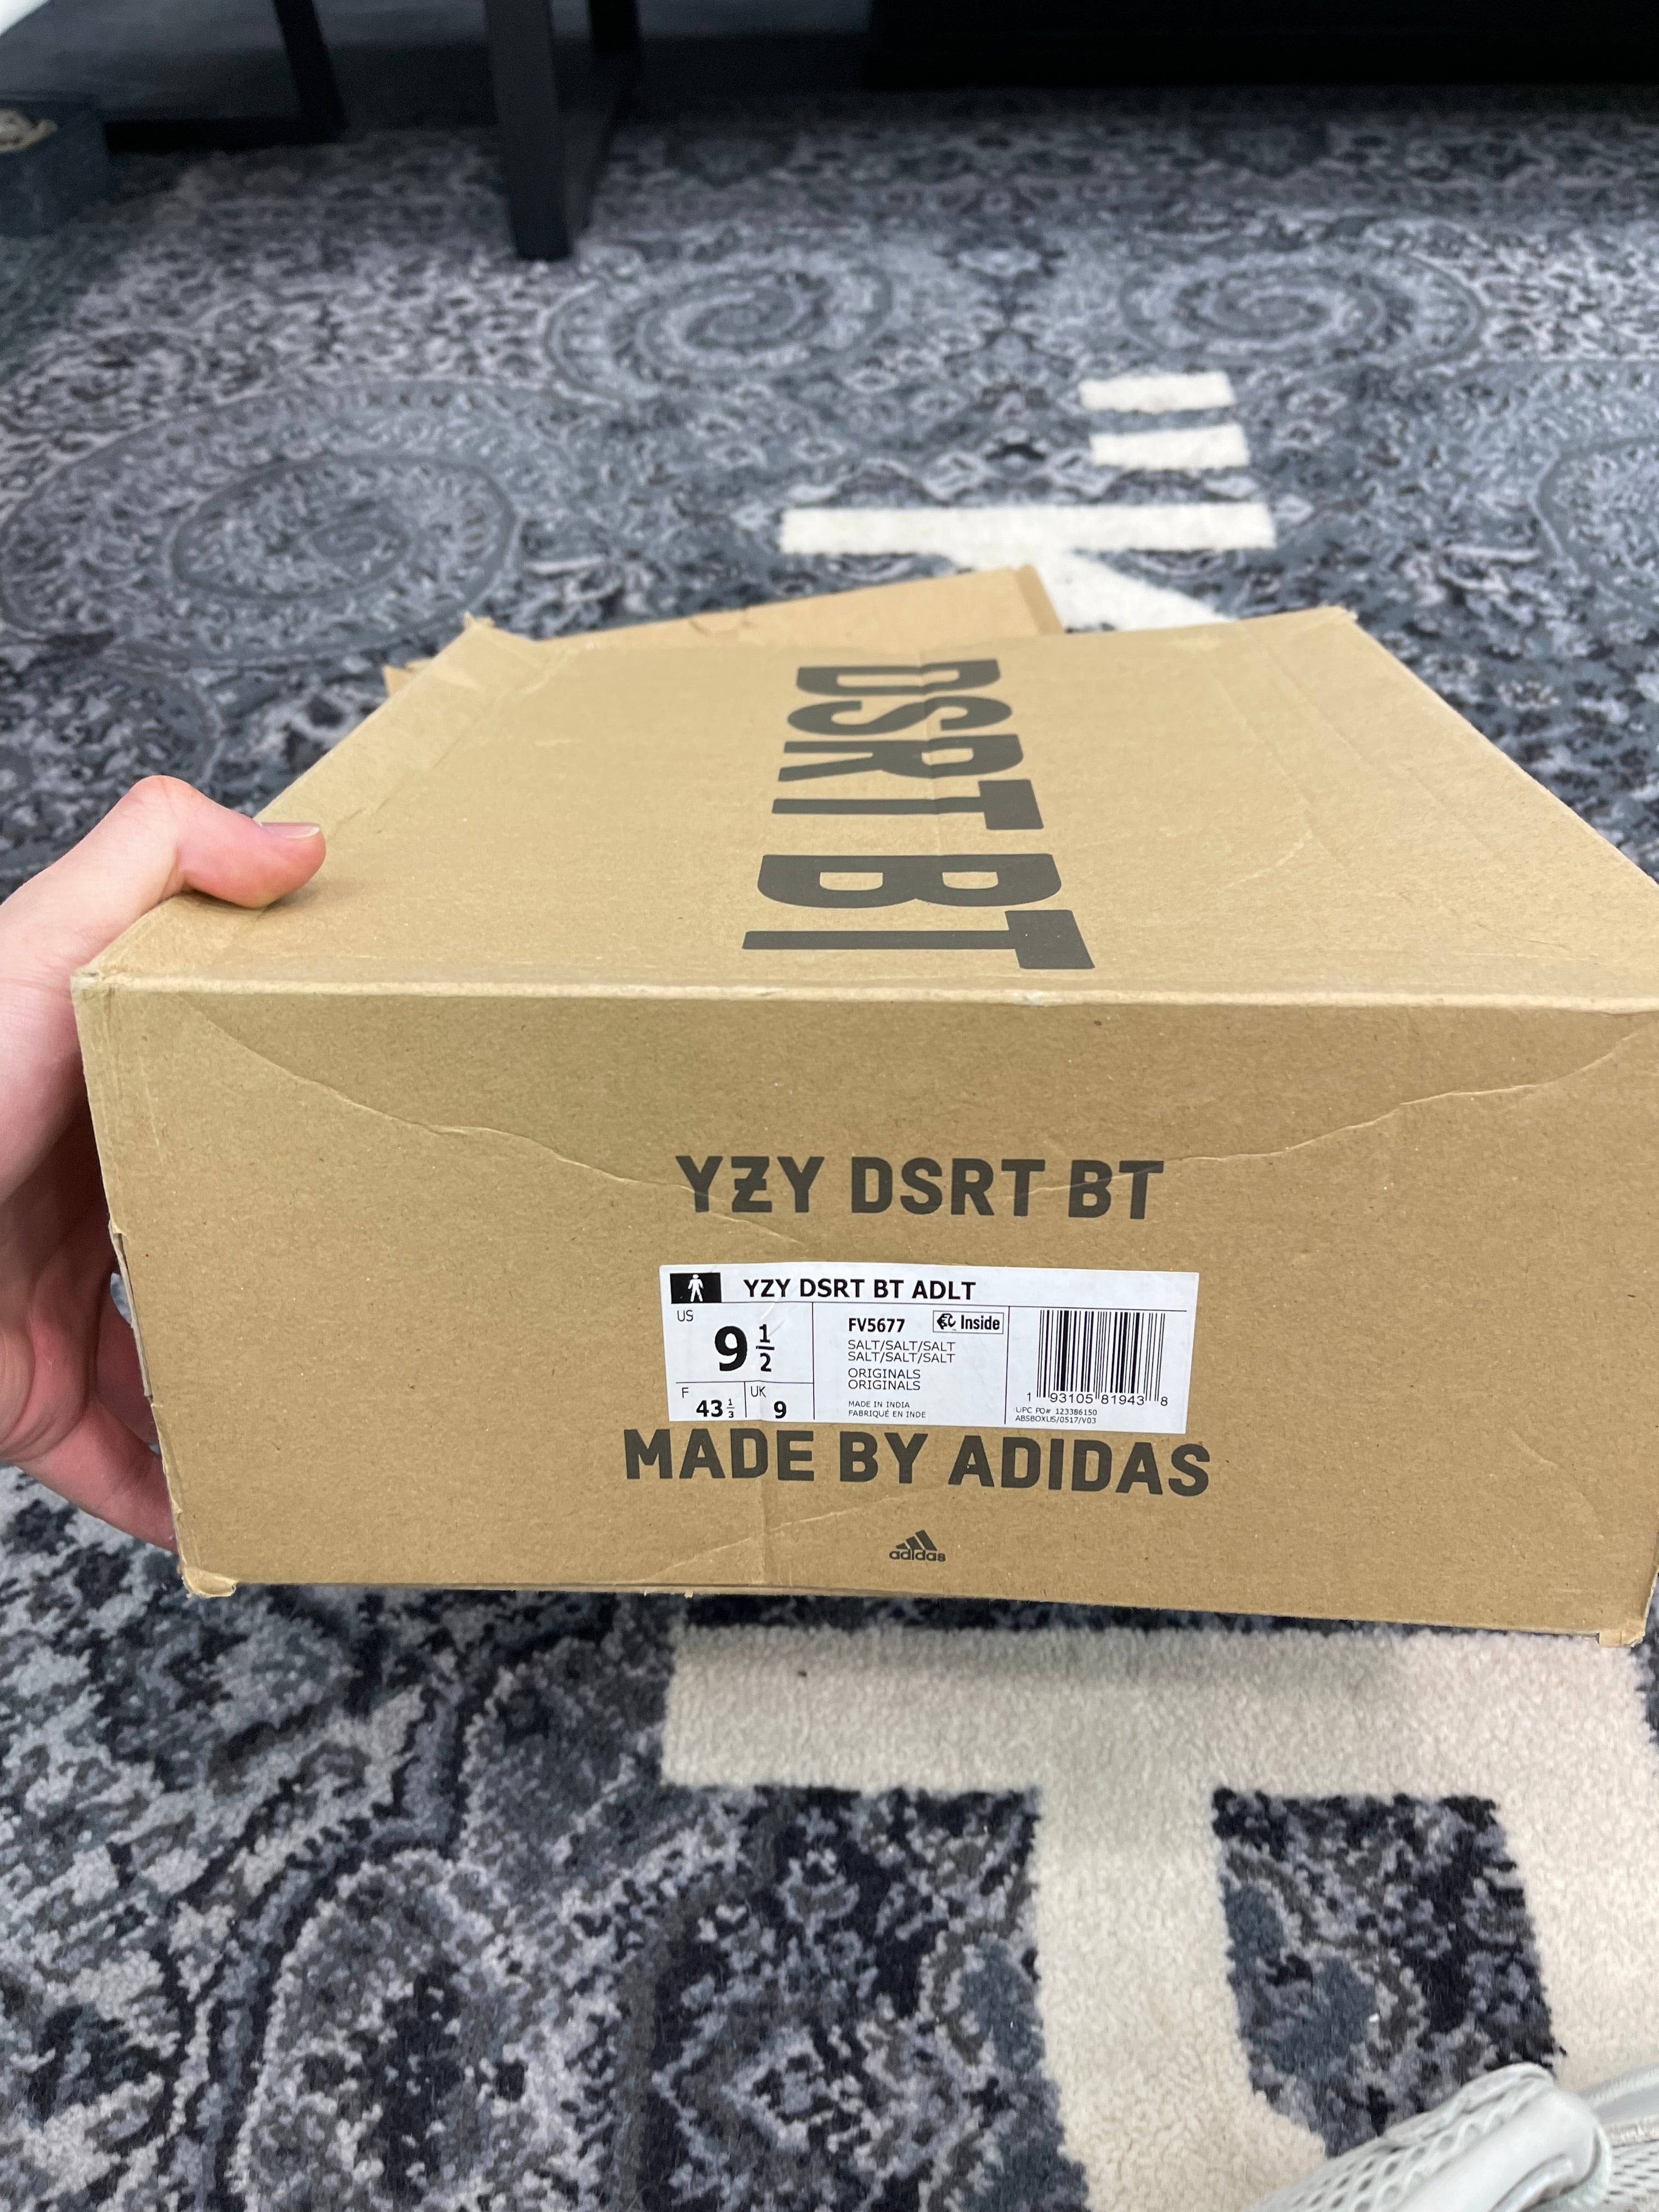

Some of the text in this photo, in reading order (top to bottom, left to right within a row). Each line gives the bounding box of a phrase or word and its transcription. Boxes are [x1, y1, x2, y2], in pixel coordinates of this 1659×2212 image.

[742, 659, 1096, 970] DSRT BT
[851, 1157, 1046, 1217] DSRT
[1069, 1160, 1165, 1220] BT
[743, 1278, 977, 1300] YZY DSRT BT ADLT
[677, 1310, 693, 1322] US
[961, 1314, 1000, 1330] Inside
[849, 1317, 905, 1333] FV5677
[714, 1325, 748, 1372] 9
[848, 1340, 956, 1351] SALT/SALT/SALT
[848, 1352, 956, 1363] SALT/SALT/SALT
[848, 1368, 921, 1379] ORIGINALS
[750, 1385, 766, 1398] UK
[848, 1379, 921, 1391] ORIGINALS
[681, 1387, 689, 1399] F
[1026, 1392, 1168, 1407] 1 93105 81943 8
[696, 1400, 723, 1418] 43
[774, 1401, 787, 1419] 9
[886, 1401, 910, 1409] INDIA
[848, 1408, 889, 1419] FABRIQUÉ
[1055, 1408, 1098, 1416] 123386150
[1015, 1415, 1097, 1424] ABSBOXUS/0517/V03
[624, 1429, 1211, 1497] MADE BY ADIDAS
[889, 1549, 946, 1562] adidas
